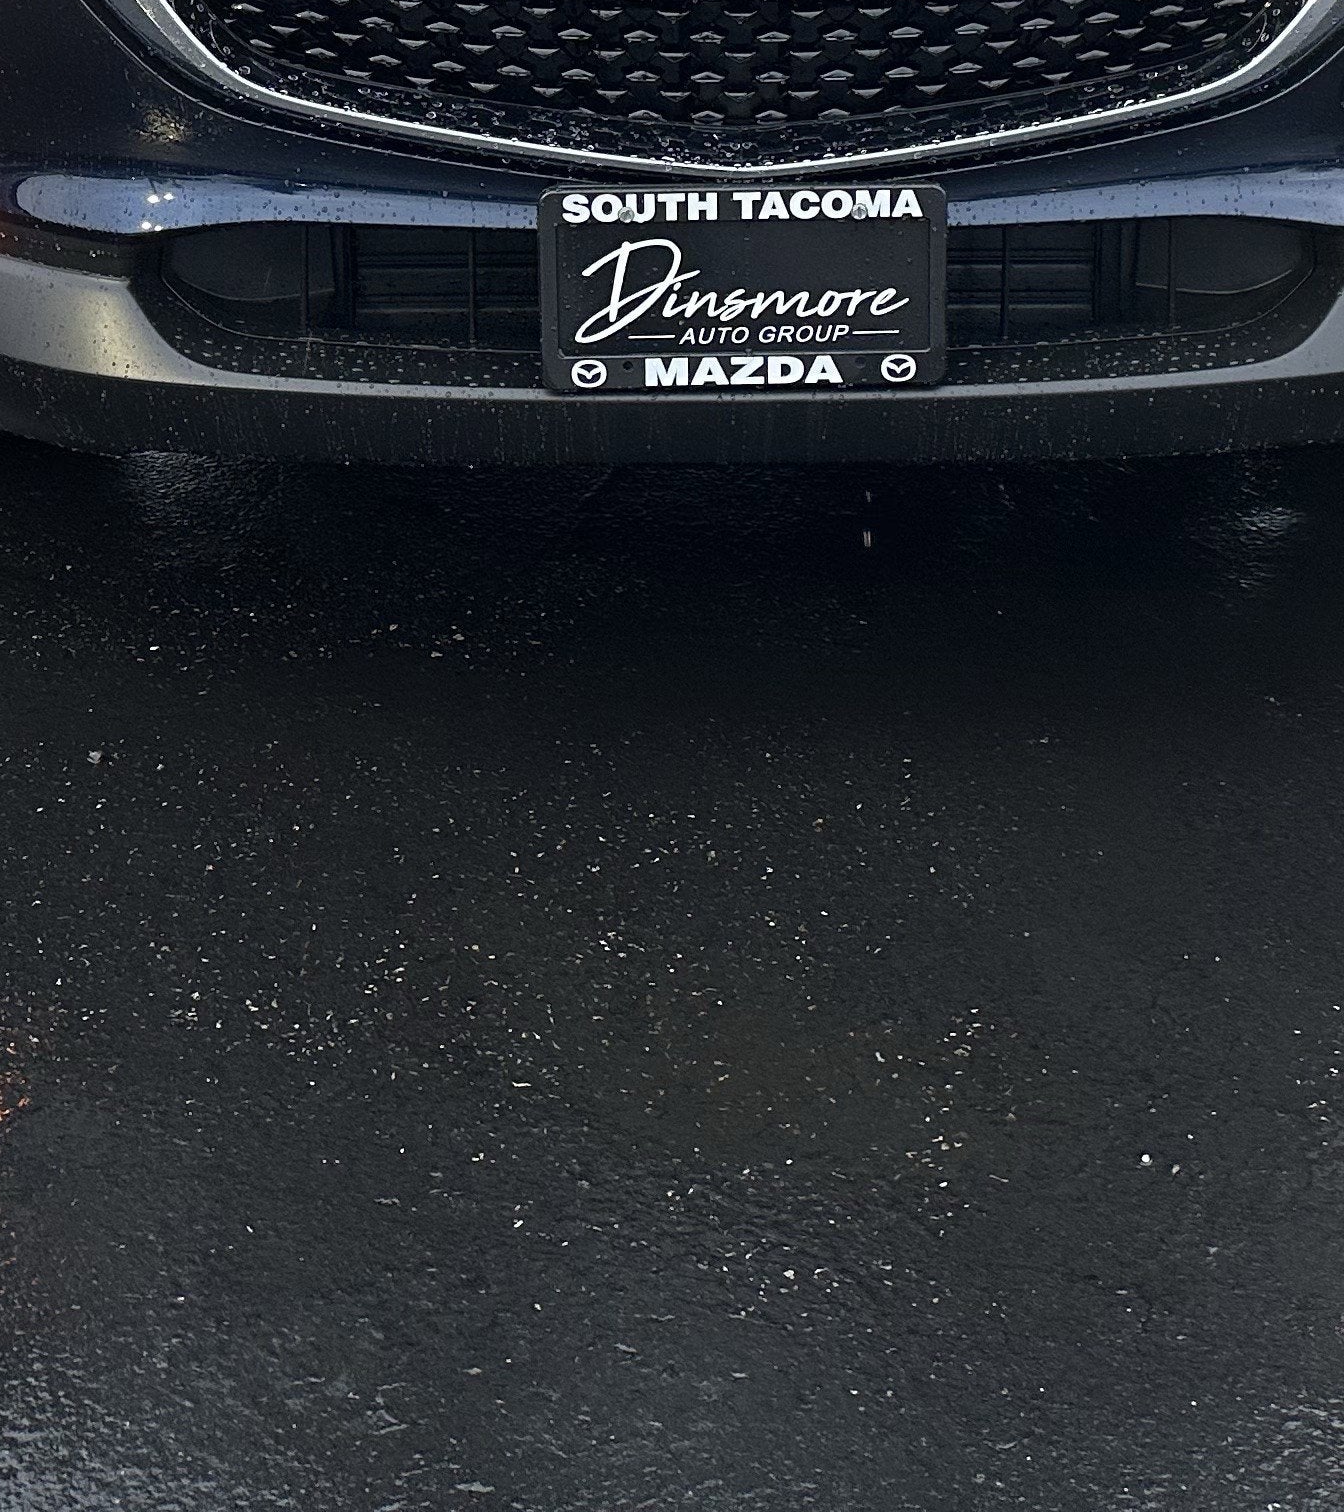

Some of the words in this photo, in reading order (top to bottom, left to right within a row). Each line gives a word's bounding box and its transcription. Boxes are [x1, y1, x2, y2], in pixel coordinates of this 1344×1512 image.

[561, 192, 719, 224] SOUTH
[732, 189, 924, 221] TACOMA
[574, 238, 910, 345] Dinsmore
[679, 326, 750, 345] AUTO
[758, 324, 851, 344] GROUP
[644, 354, 844, 387] MAZDA
